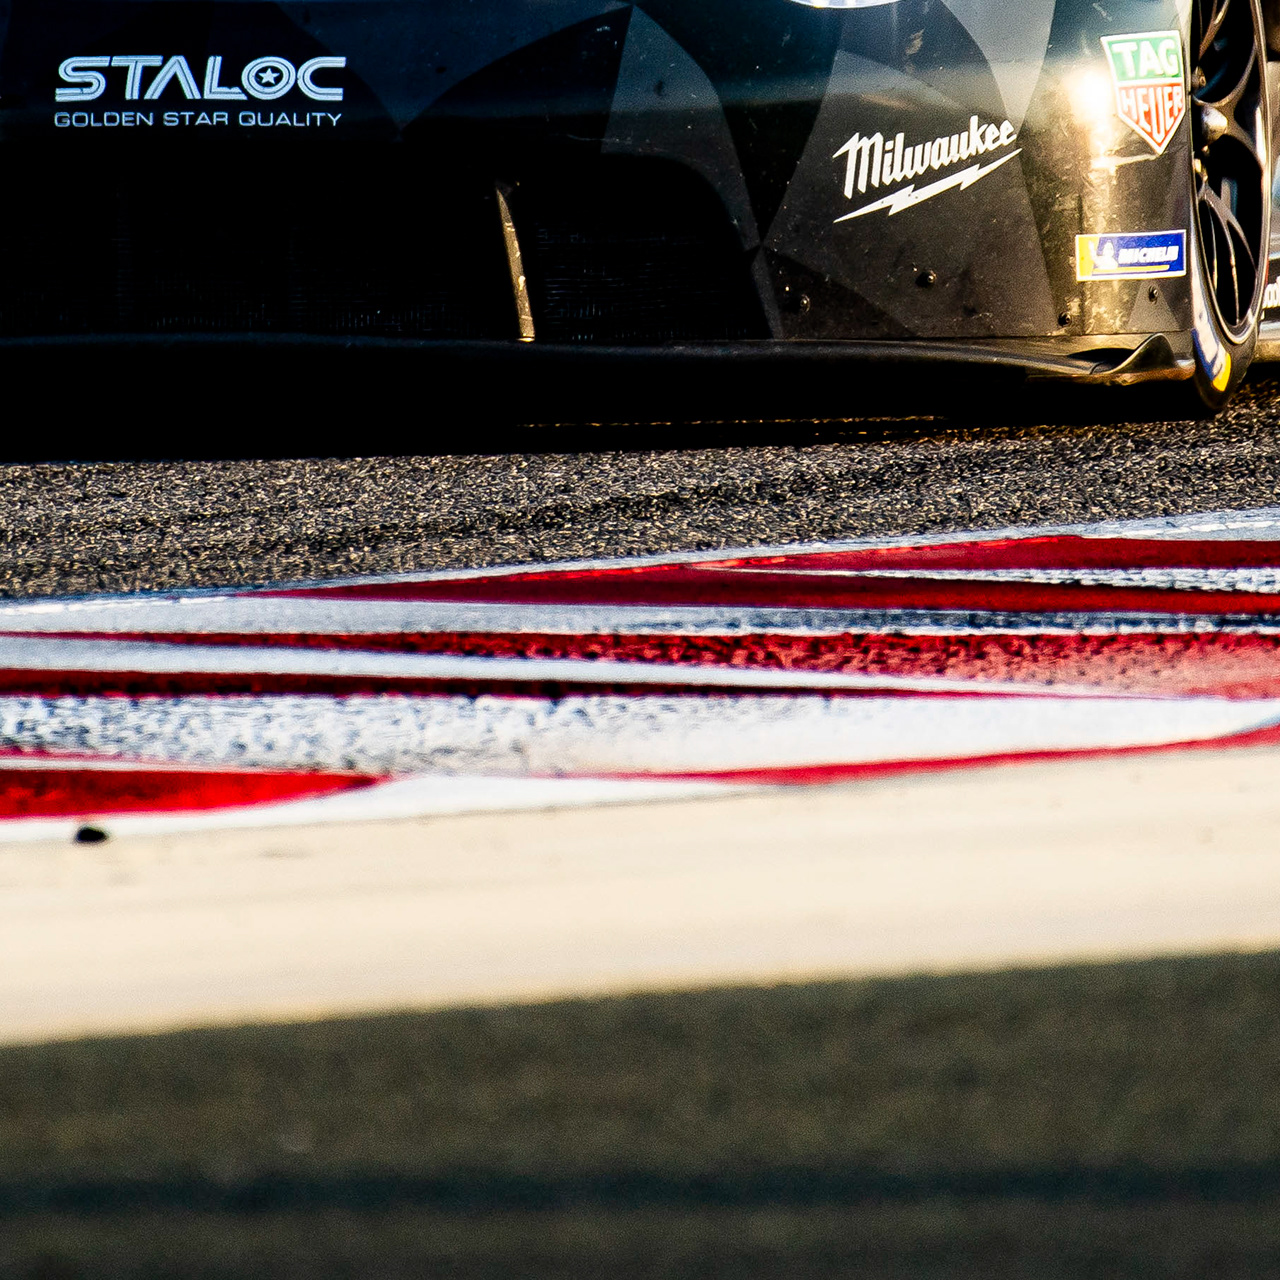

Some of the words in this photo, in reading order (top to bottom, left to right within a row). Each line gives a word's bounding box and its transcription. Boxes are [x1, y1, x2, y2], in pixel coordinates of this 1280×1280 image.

[54, 55, 347, 102] STALOC
[1111, 39, 1179, 77] TAG
[53, 111, 155, 128] GOLDEN
[162, 111, 229, 126] STAR
[238, 111, 342, 127] QUALITY
[1121, 84, 1184, 139] HEUER
[833, 115, 1017, 199] Milwaukee
[1117, 245, 1180, 264] MICHELIN
